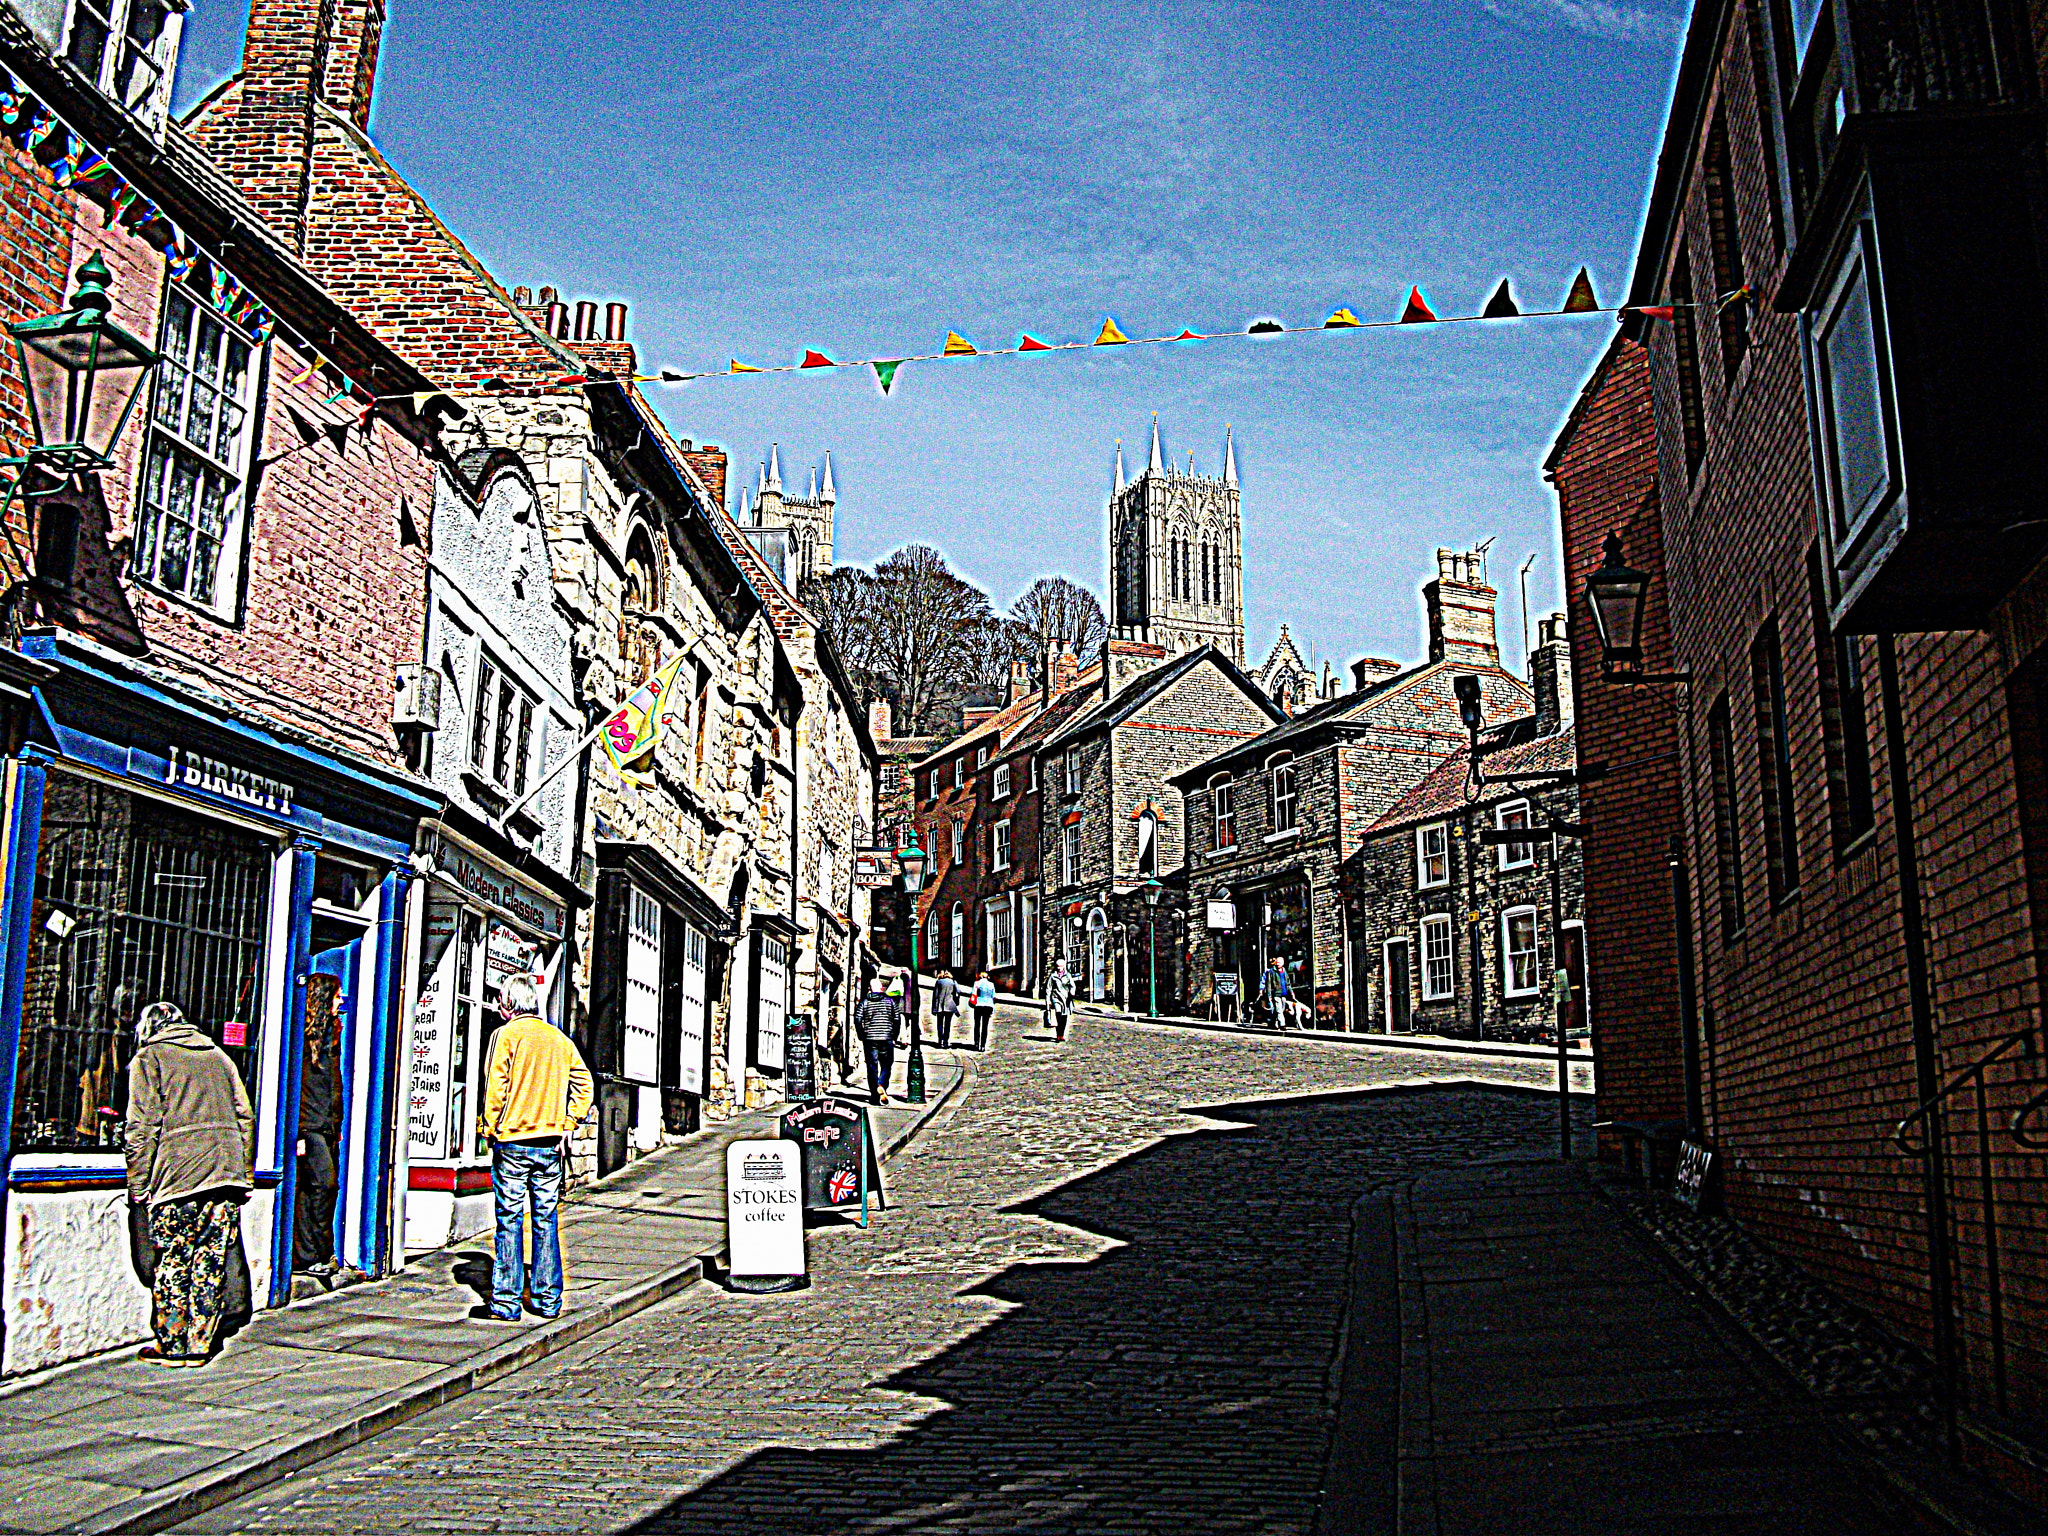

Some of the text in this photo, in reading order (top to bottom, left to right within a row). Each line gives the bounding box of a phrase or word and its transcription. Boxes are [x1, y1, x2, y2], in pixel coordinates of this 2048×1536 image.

[856, 874, 891, 885] BOOKS
[502, 882, 545, 930] Classics
[733, 1190, 797, 1204] STOKES
[745, 1208, 786, 1222] coffee
